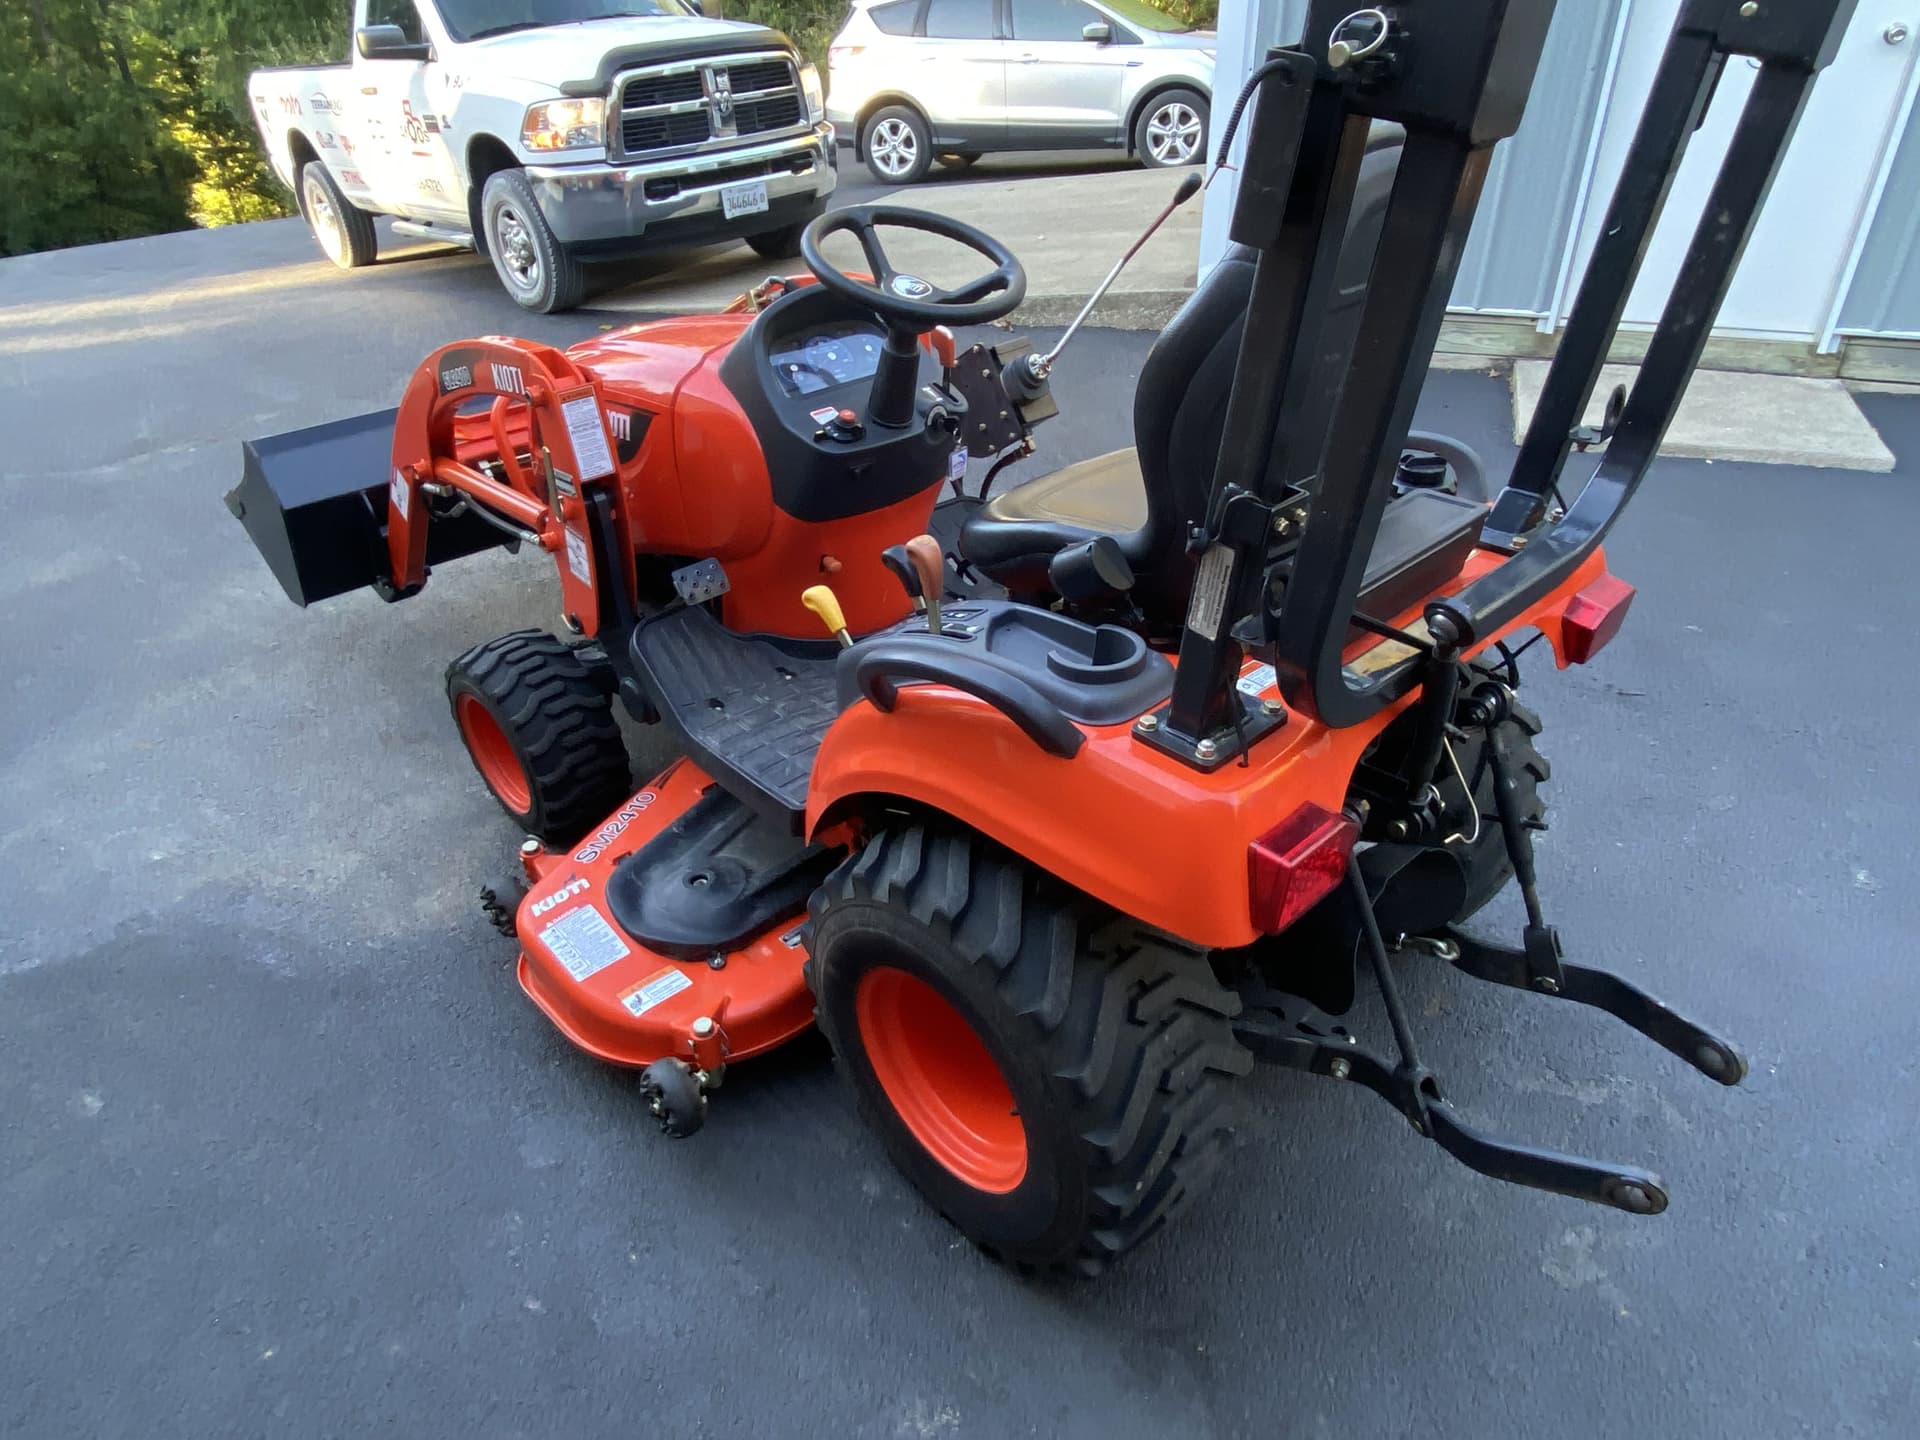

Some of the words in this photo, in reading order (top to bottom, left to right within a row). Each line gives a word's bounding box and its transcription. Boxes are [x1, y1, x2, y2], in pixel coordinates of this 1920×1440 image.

[491, 362, 525, 395] KIOTI
[606, 408, 631, 441] IOTI
[575, 791, 657, 864] SM2410
[531, 877, 591, 917] KIOTI
